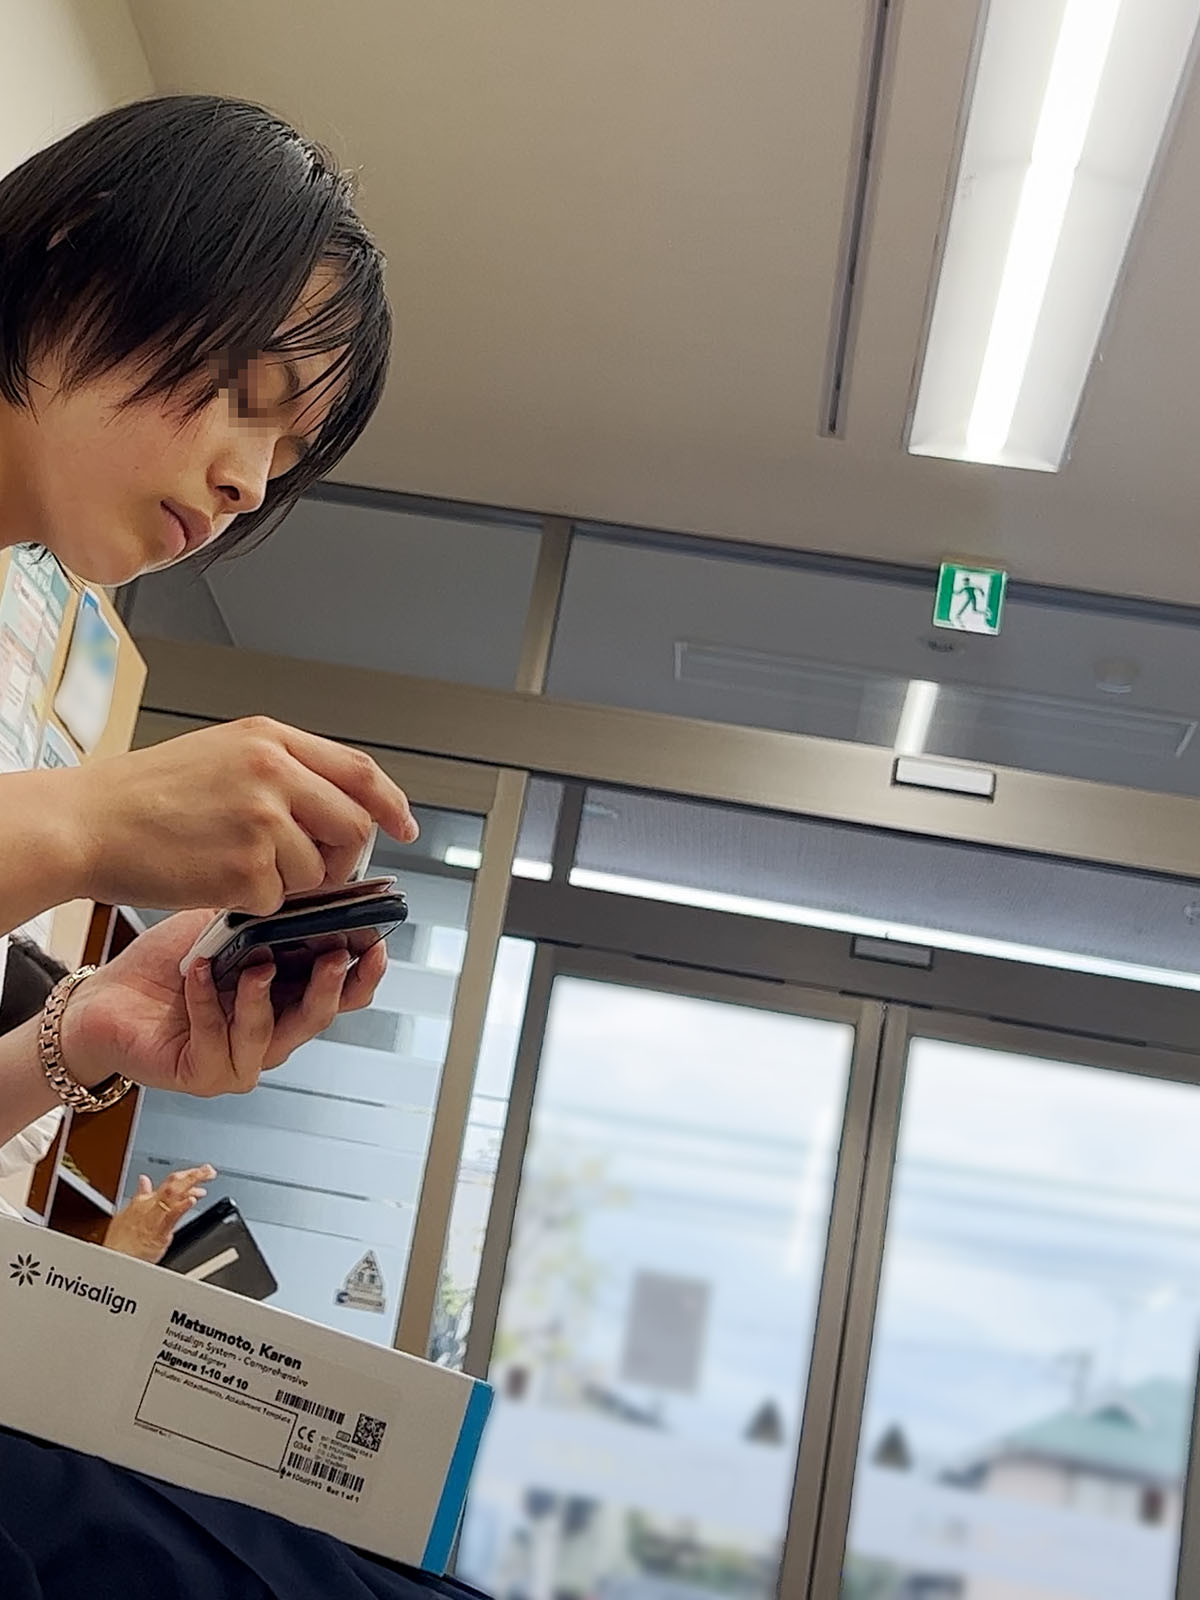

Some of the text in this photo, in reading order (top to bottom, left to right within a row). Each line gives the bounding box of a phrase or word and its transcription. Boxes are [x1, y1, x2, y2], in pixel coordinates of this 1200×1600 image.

[45, 1266, 137, 1314] invisalign
[162, 1339, 227, 1368] Additional Aligners
[166, 1327, 204, 1349] Invisalign
[206, 1341, 236, 1360] System
[243, 1357, 309, 1388] Comprehensive
[170, 1310, 302, 1370] Matsumoto, Karen
[157, 1350, 249, 1391] Aligners 1-10 of 10
[263, 1408, 291, 1424] Template
[298, 1426, 316, 1443] CE
